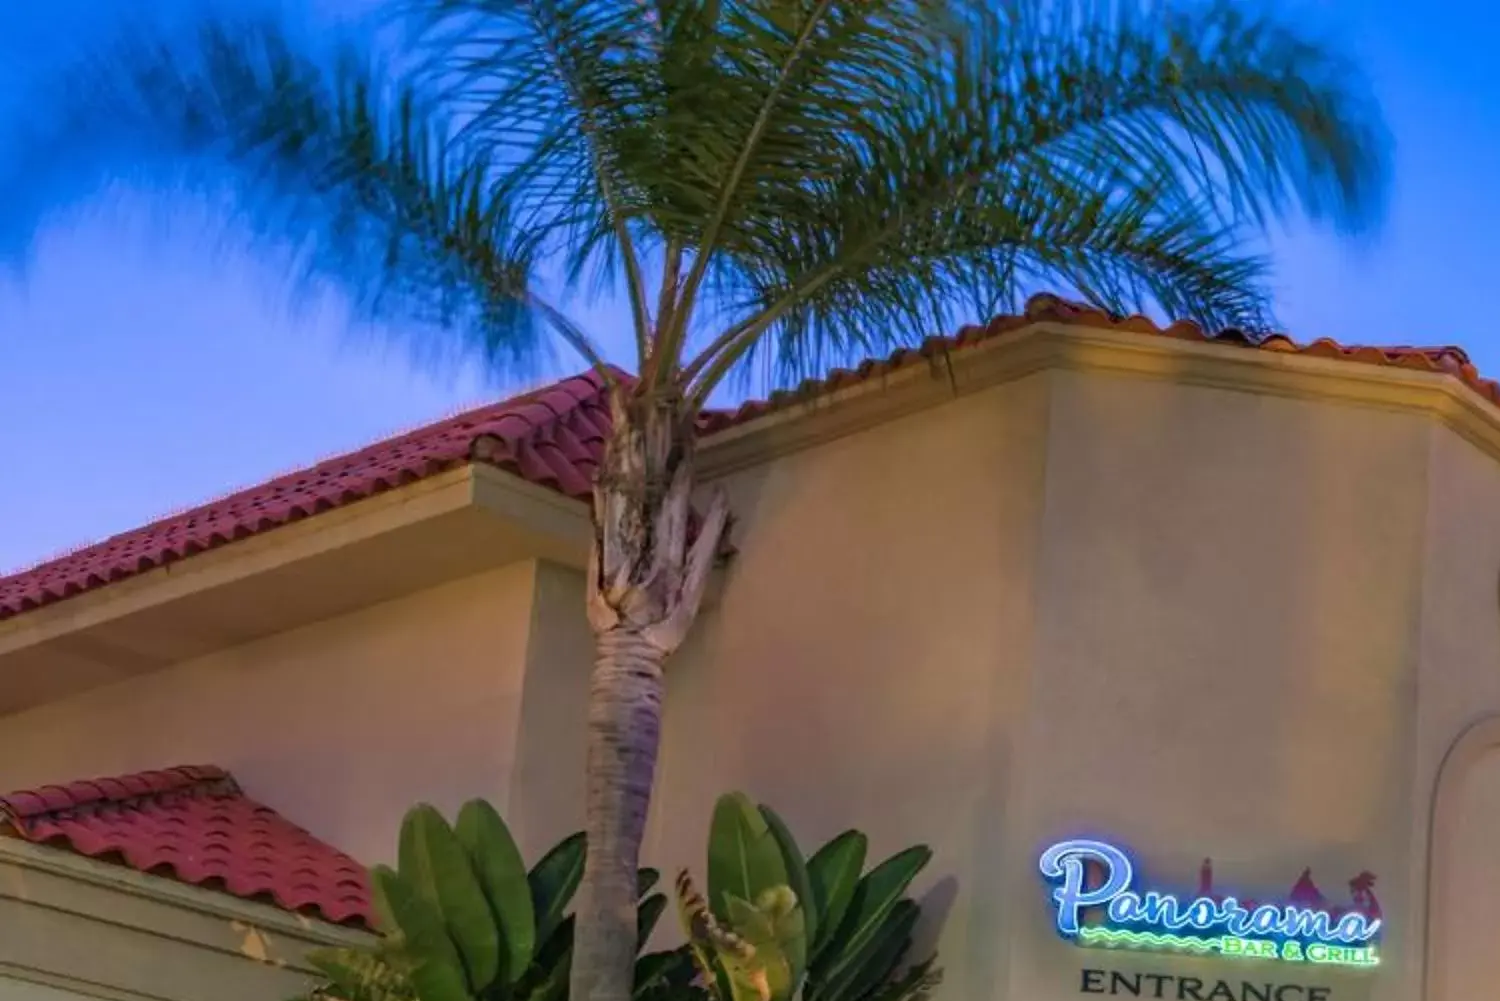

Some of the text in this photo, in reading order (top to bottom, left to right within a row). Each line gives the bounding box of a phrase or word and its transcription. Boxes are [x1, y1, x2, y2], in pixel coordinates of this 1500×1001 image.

[1039, 839, 1381, 942] Panorama
[1221, 935, 1381, 965] BAR & GRILL
